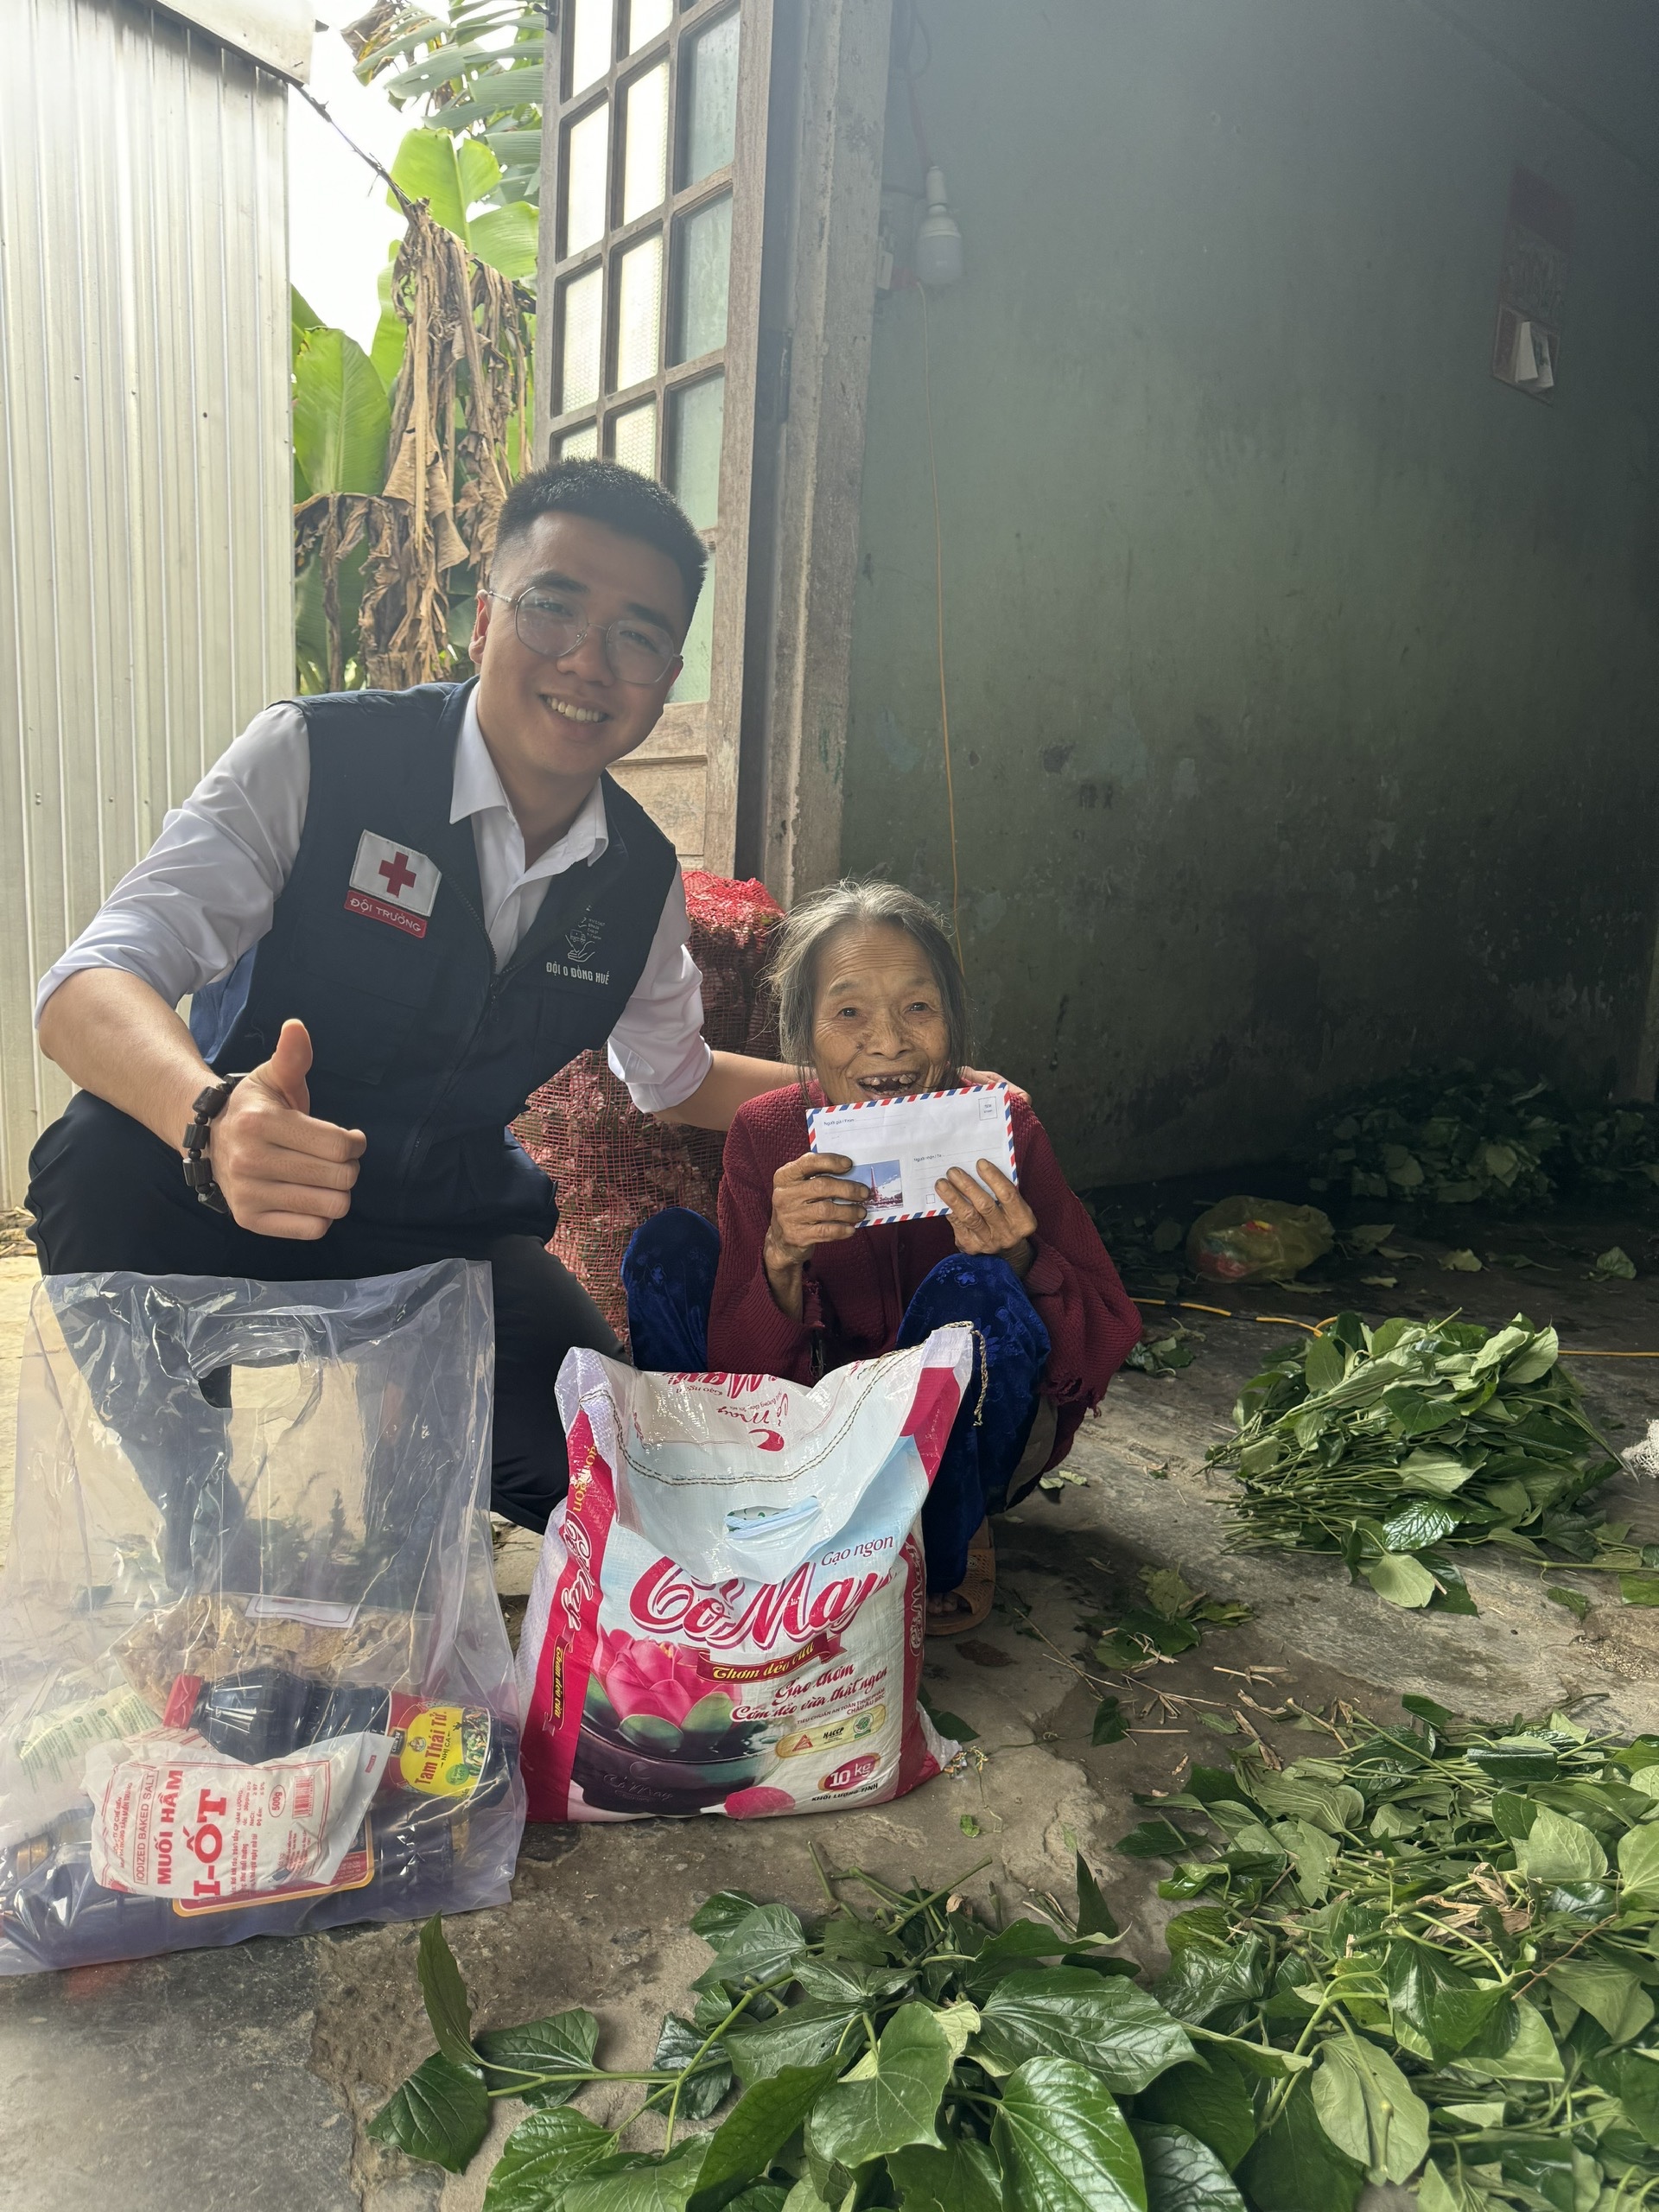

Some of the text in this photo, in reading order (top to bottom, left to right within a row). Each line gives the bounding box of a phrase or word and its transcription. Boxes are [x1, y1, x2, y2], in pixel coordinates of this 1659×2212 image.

[350, 898, 372, 912] ĐỘI
[546, 961, 560, 976] ĐỘI
[571, 965, 593, 981] ĐỒNG
[595, 971, 610, 984] HUẾ
[586, 1446, 597, 1465] ạo
[822, 1535, 893, 1567] Gạo ngon
[706, 1561, 897, 1650] May
[713, 1666, 760, 1679] Thơm
[772, 1663, 856, 1707] Gạo thơm
[732, 1705, 772, 1721] Cơm
[856, 1666, 889, 1694] ngon
[415, 1712, 447, 1784] Tam Thái Tử
[441, 1737, 451, 1761] NHỊ CA
[830, 1762, 872, 1788] 10 kg
[271, 1791, 283, 1811] 500g
[137, 1772, 155, 1881] IODIZED BAKED SALT
[154, 1770, 184, 1885] MUỐI HẦM
[182, 1789, 226, 1897] I-ỐT
